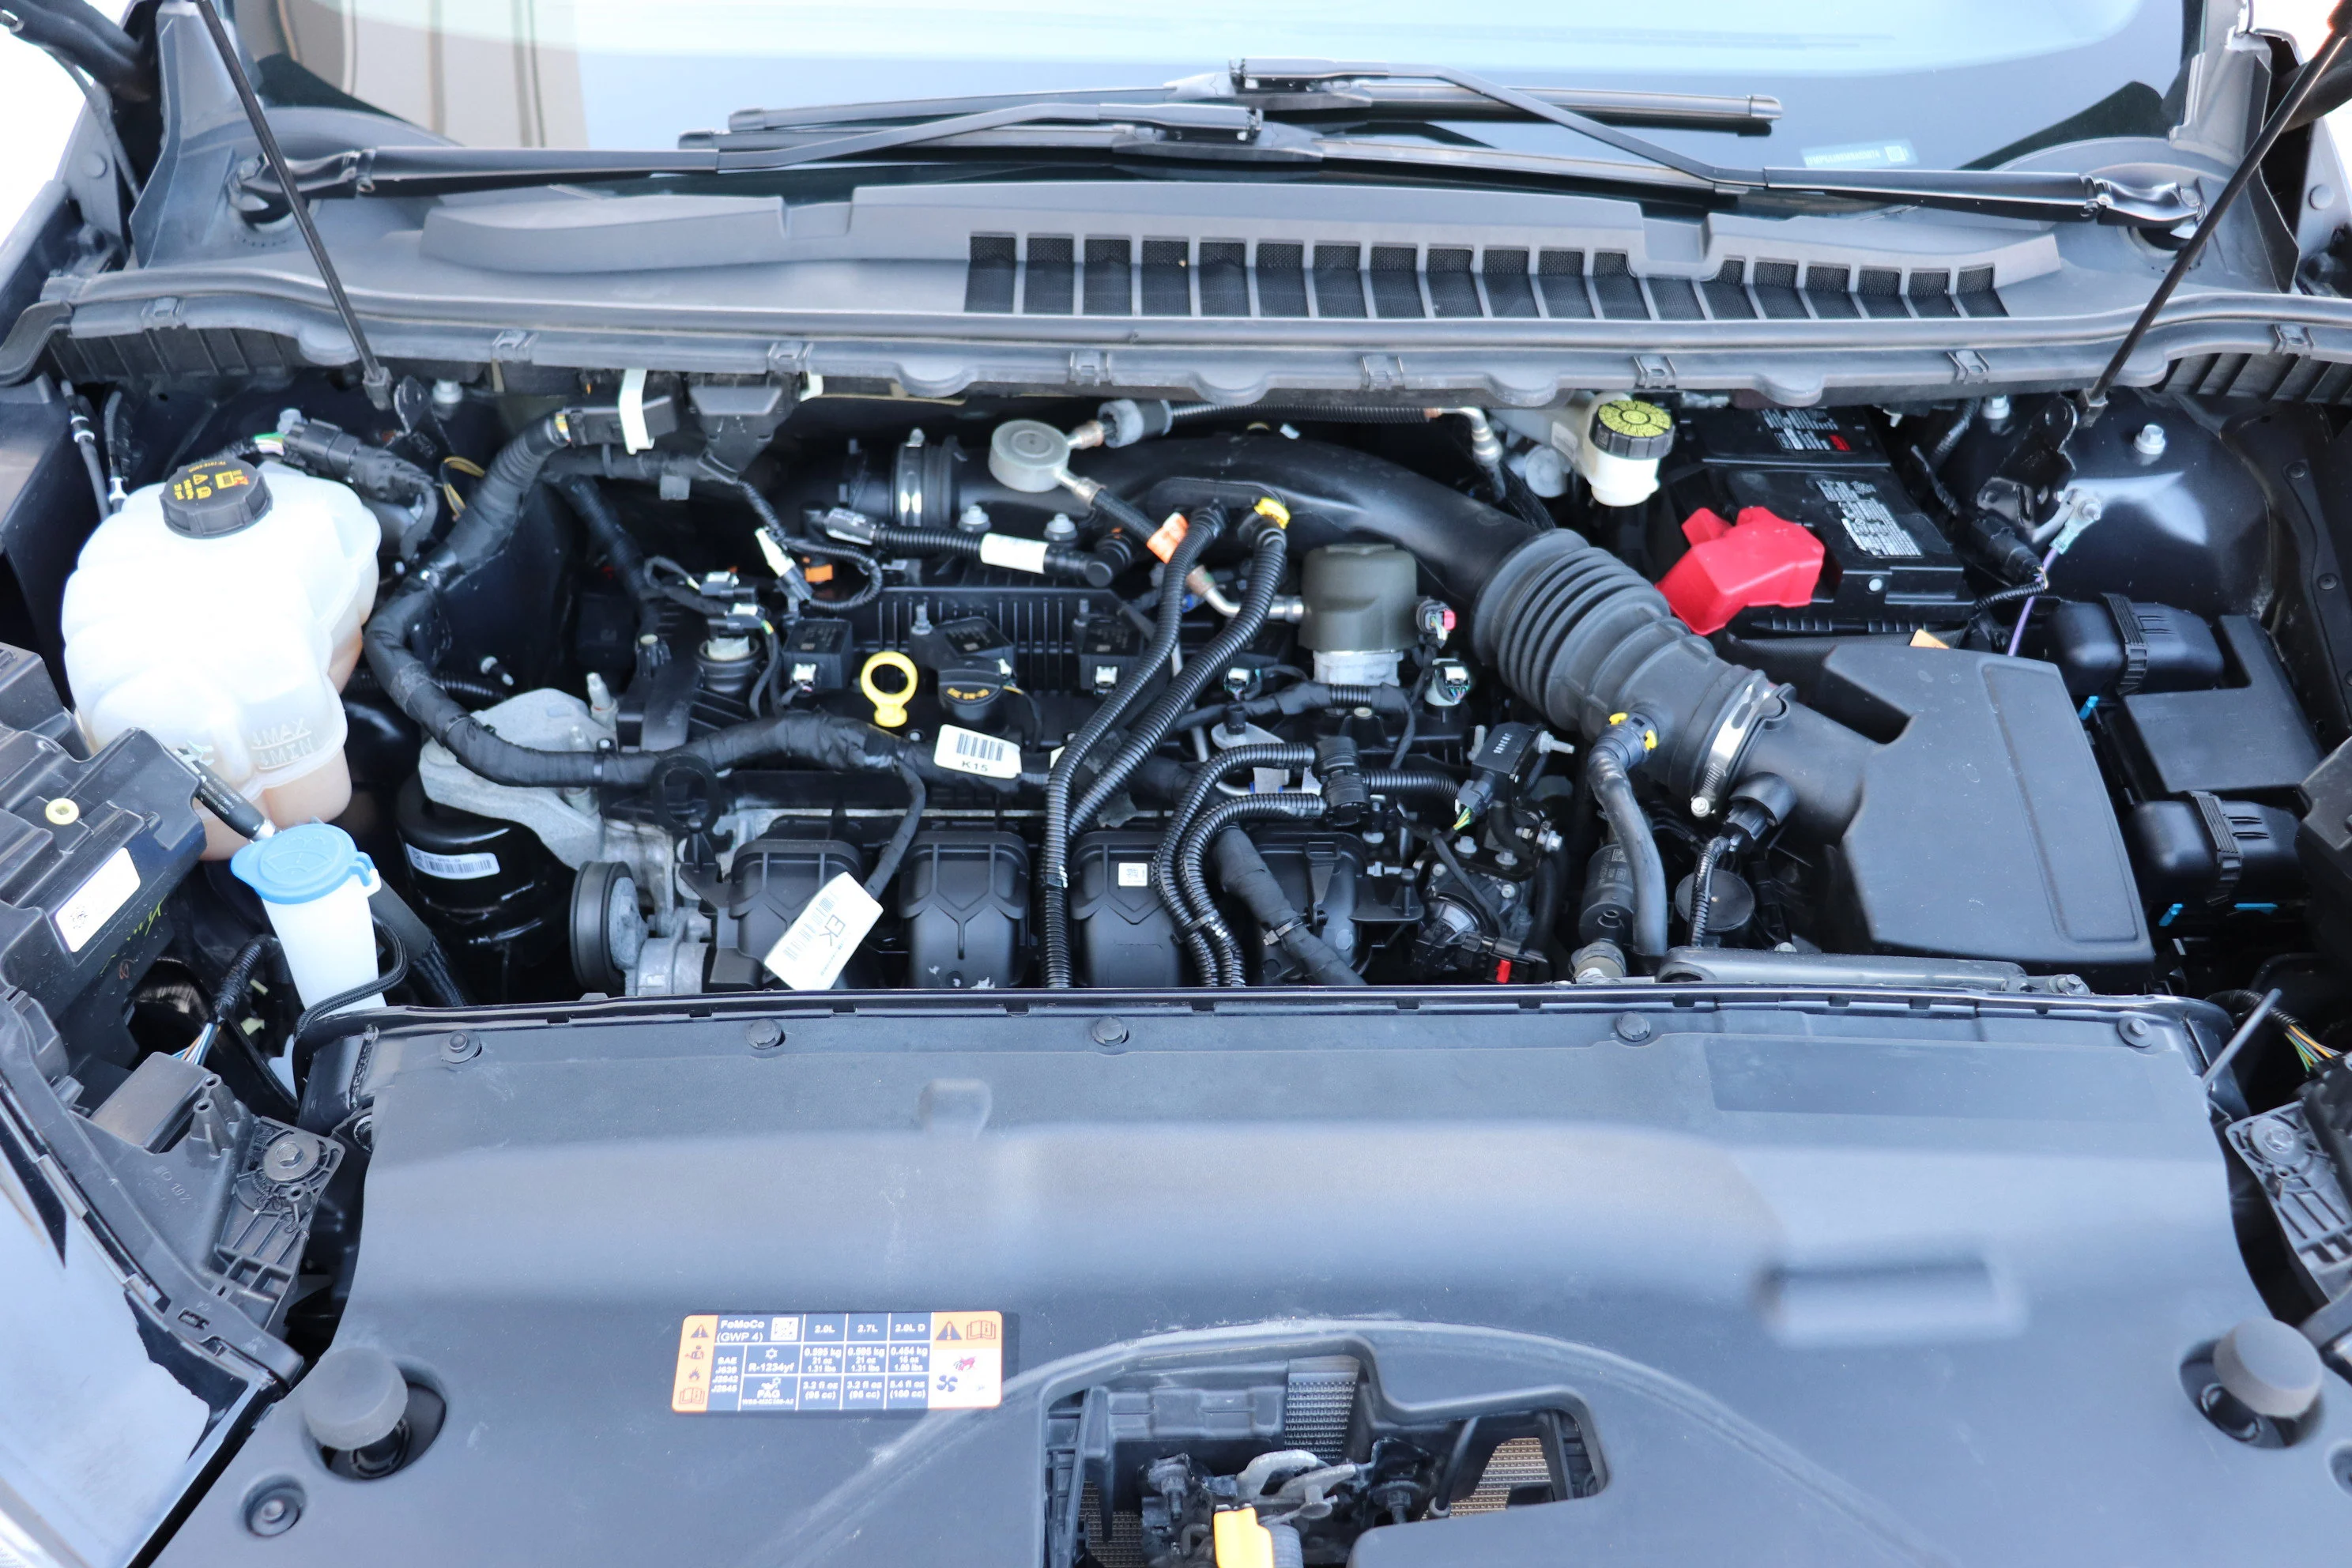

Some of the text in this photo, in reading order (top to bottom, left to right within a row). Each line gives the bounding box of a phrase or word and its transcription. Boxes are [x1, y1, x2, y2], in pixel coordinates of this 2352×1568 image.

[261, 717, 310, 744] MAX
[269, 737, 315, 766] MIN
[962, 760, 989, 772] K15
[819, 914, 846, 947] EK
[721, 1320, 765, 1329] FoMoCo
[857, 1324, 878, 1333] 2.7L
[918, 1323, 925, 1332] D
[717, 1332, 763, 1343] (GWP 4)
[830, 1348, 842, 1359] kg
[873, 1348, 885, 1358] kg
[917, 1347, 928, 1357] kg
[748, 1363, 794, 1373] R-1234yf
